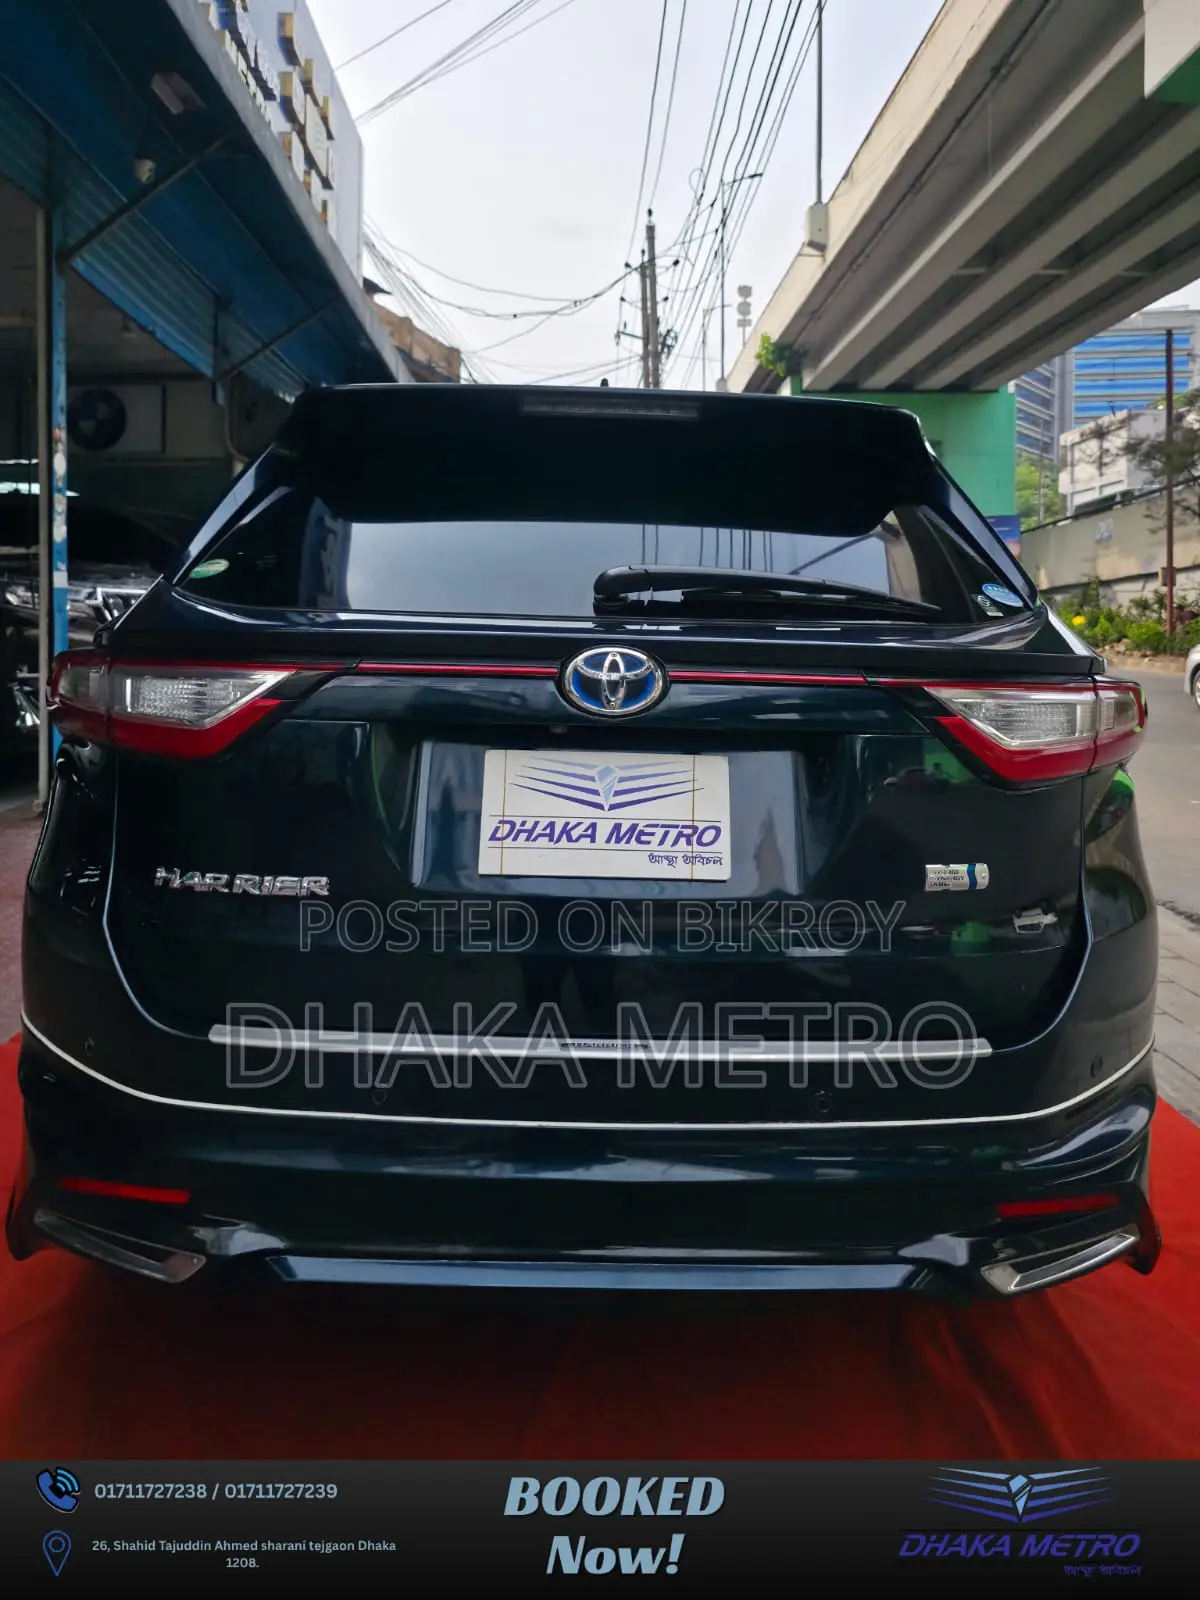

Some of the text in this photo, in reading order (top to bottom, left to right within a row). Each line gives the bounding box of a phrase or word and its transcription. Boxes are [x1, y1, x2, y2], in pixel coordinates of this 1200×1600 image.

[488, 820, 722, 847] DHAKA METRO
[154, 866, 330, 897] HARRIER
